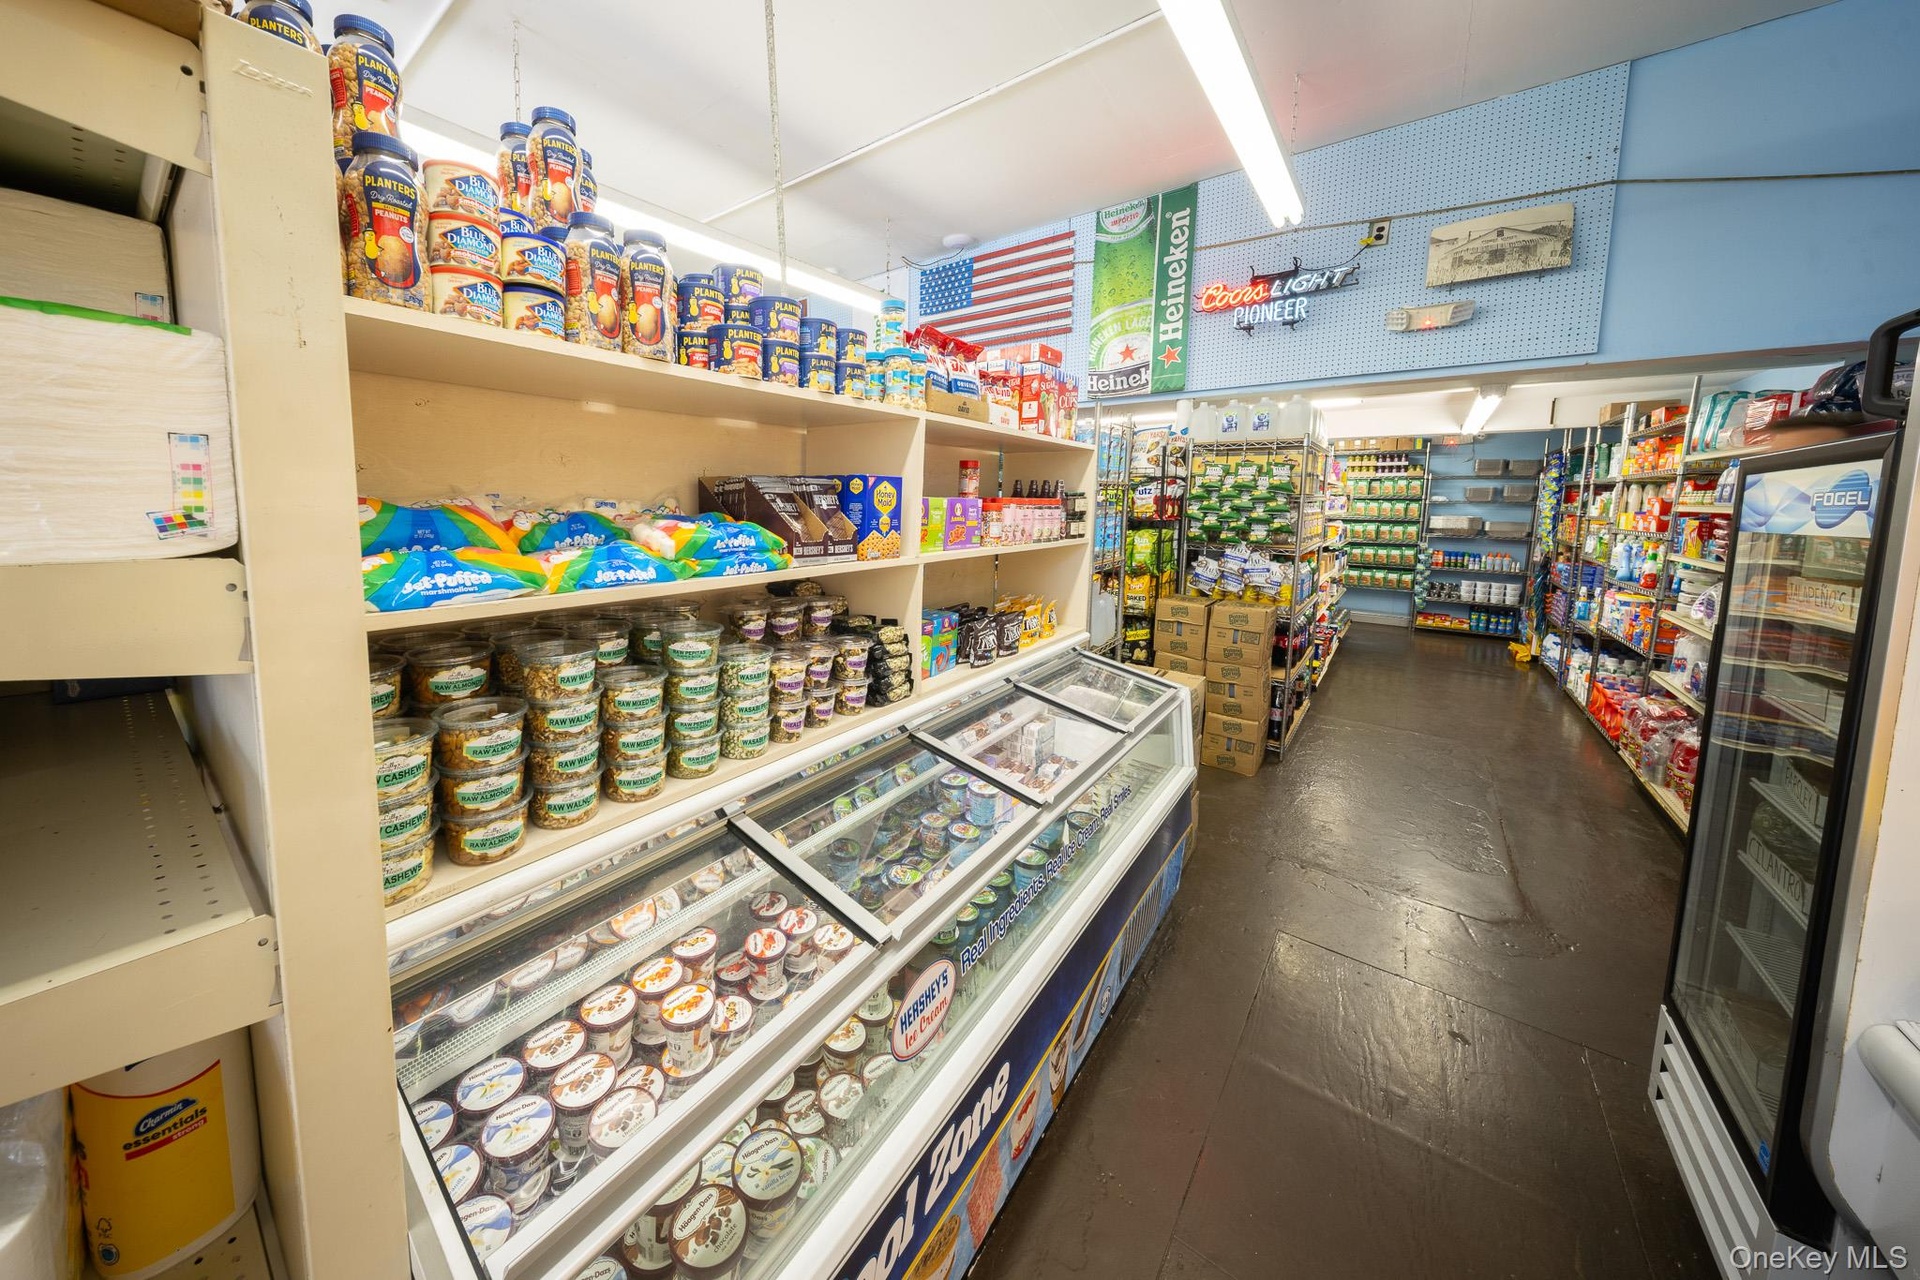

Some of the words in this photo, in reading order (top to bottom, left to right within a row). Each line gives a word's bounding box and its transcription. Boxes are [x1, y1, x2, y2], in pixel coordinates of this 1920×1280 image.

[250, 17, 304, 45] PLANTERS
[358, 55, 400, 84] PLANTERS
[543, 138, 577, 156] PLANTERS
[364, 175, 416, 200] PLANTERS
[469, 175, 492, 192] BLUE
[370, 190, 386, 205] Dry
[385, 194, 413, 210] Roasted
[455, 180, 499, 206] DIAMOND
[374, 209, 409, 224] PEANUTS
[447, 232, 496, 254] DIAMOND
[461, 226, 486, 242] BLUE
[537, 246, 559, 260] BLUE
[630, 261, 665, 276] PLANTERS
[1158, 208, 1191, 344] Heineken
[476, 281, 497, 298] BLUE
[1201, 280, 1270, 312] Coors
[1270, 267, 1356, 299] LIGHT
[1233, 298, 1307, 328] PIONEER
[683, 336, 708, 346] PLANT
[1087, 368, 1150, 394] Heinek
[877, 489, 895, 499] Honey
[878, 498, 893, 507] Maid
[1812, 490, 1870, 507] FOGEL
[723, 562, 767, 576] Jet-Puffed
[402, 571, 492, 594] Jet-Puffed
[421, 585, 478, 597] marshmallows
[452, 679, 483, 690] ALMONDS
[560, 675, 578, 685] RAW
[578, 670, 594, 682] WALN
[617, 700, 631, 708] RAW
[631, 697, 650, 707] MIXED
[549, 717, 568, 726] RAW
[622, 741, 635, 749] RAW
[635, 738, 653, 748] MIXED
[383, 760, 426, 783] CASHEWS
[558, 759, 577, 769] RAW
[618, 779, 632, 787] RAW
[632, 776, 651, 785] MIXED
[461, 795, 479, 803] RAW
[480, 785, 514, 801] ALMONDS
[472, 787, 502, 796] CALIFORNIA
[547, 803, 566, 812] RAW
[384, 810, 427, 835] CASHEWS
[469, 841, 487, 849] RAW
[481, 834, 512, 843] CALIFORNIA
[384, 863, 423, 886] ASHEWS
[1749, 837, 1802, 903] CILANTRO
[960, 928, 988, 977] Real
[1045, 855, 1065, 883] Real
[1099, 803, 1114, 823] Real
[900, 967, 949, 1035] HERSHEY'S
[905, 1030, 918, 1050] Ice
[919, 997, 948, 1033] Cream
[138, 1102, 185, 1133] Charmin
[123, 1107, 207, 1151] essentials
[172, 1119, 206, 1140] strong
[924, 1061, 1010, 1216] Zone
[742, 1136, 779, 1160] Häagen-Dazs
[762, 1177, 779, 1192] vanilla
[678, 1191, 715, 1233] Häagen-Dazs
[713, 1223, 738, 1254] chocolate
